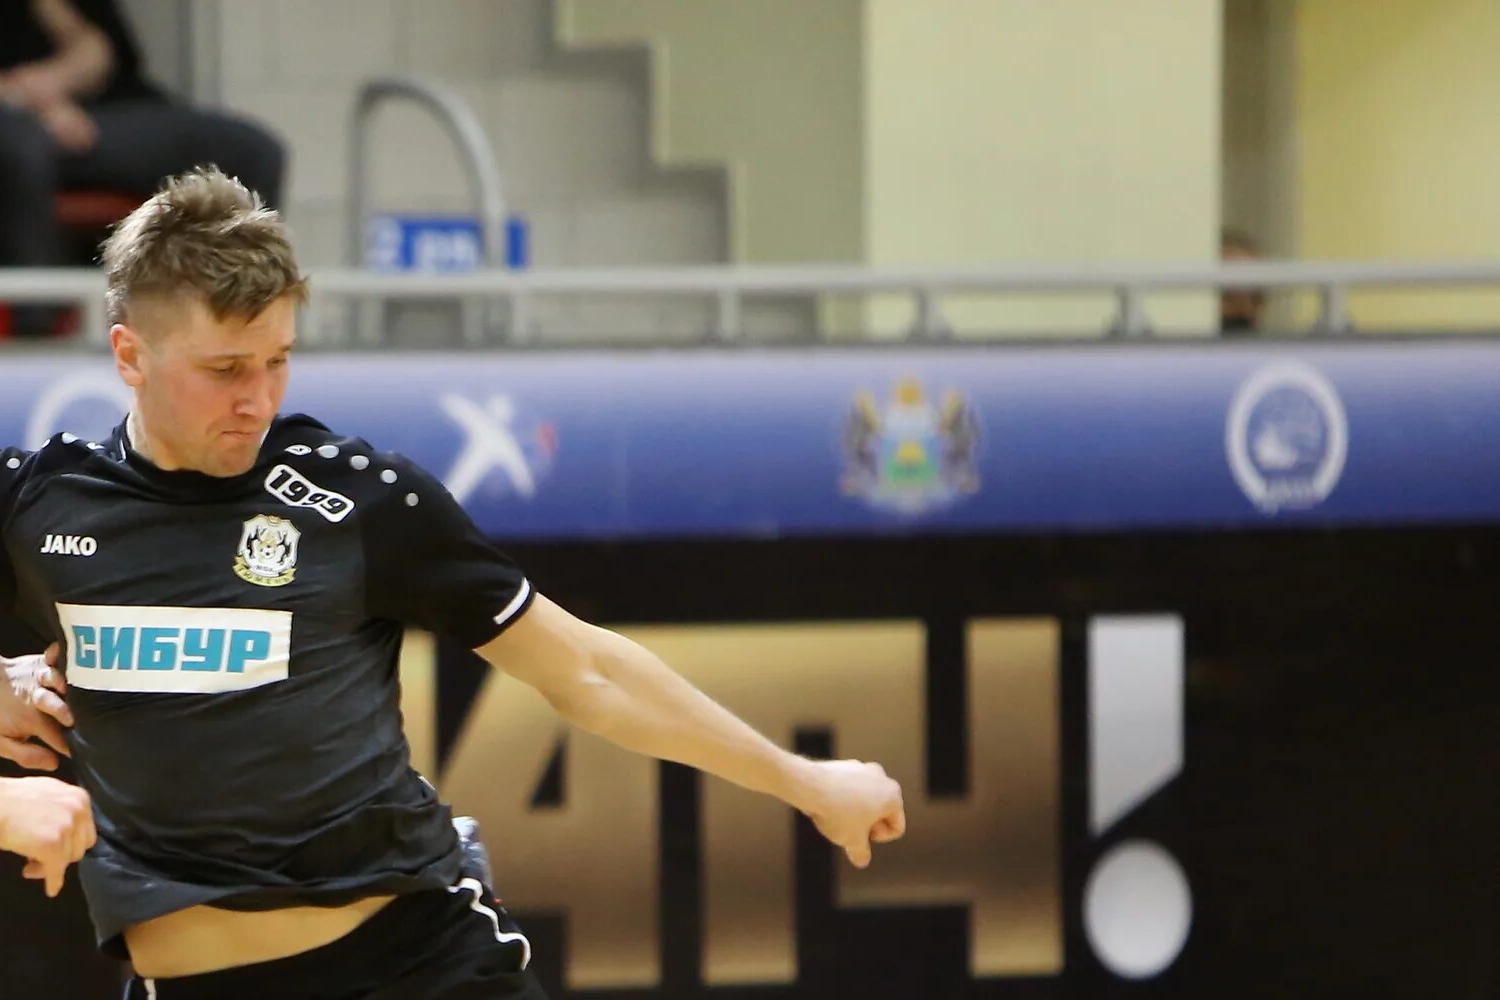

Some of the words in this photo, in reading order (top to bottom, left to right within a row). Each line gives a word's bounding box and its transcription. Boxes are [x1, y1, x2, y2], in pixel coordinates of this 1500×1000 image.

[269, 468, 348, 515] 1999
[40, 534, 98, 557] JAKO
[71, 624, 271, 673] СИБУР
[400, 612, 1194, 990] АТЧ!
